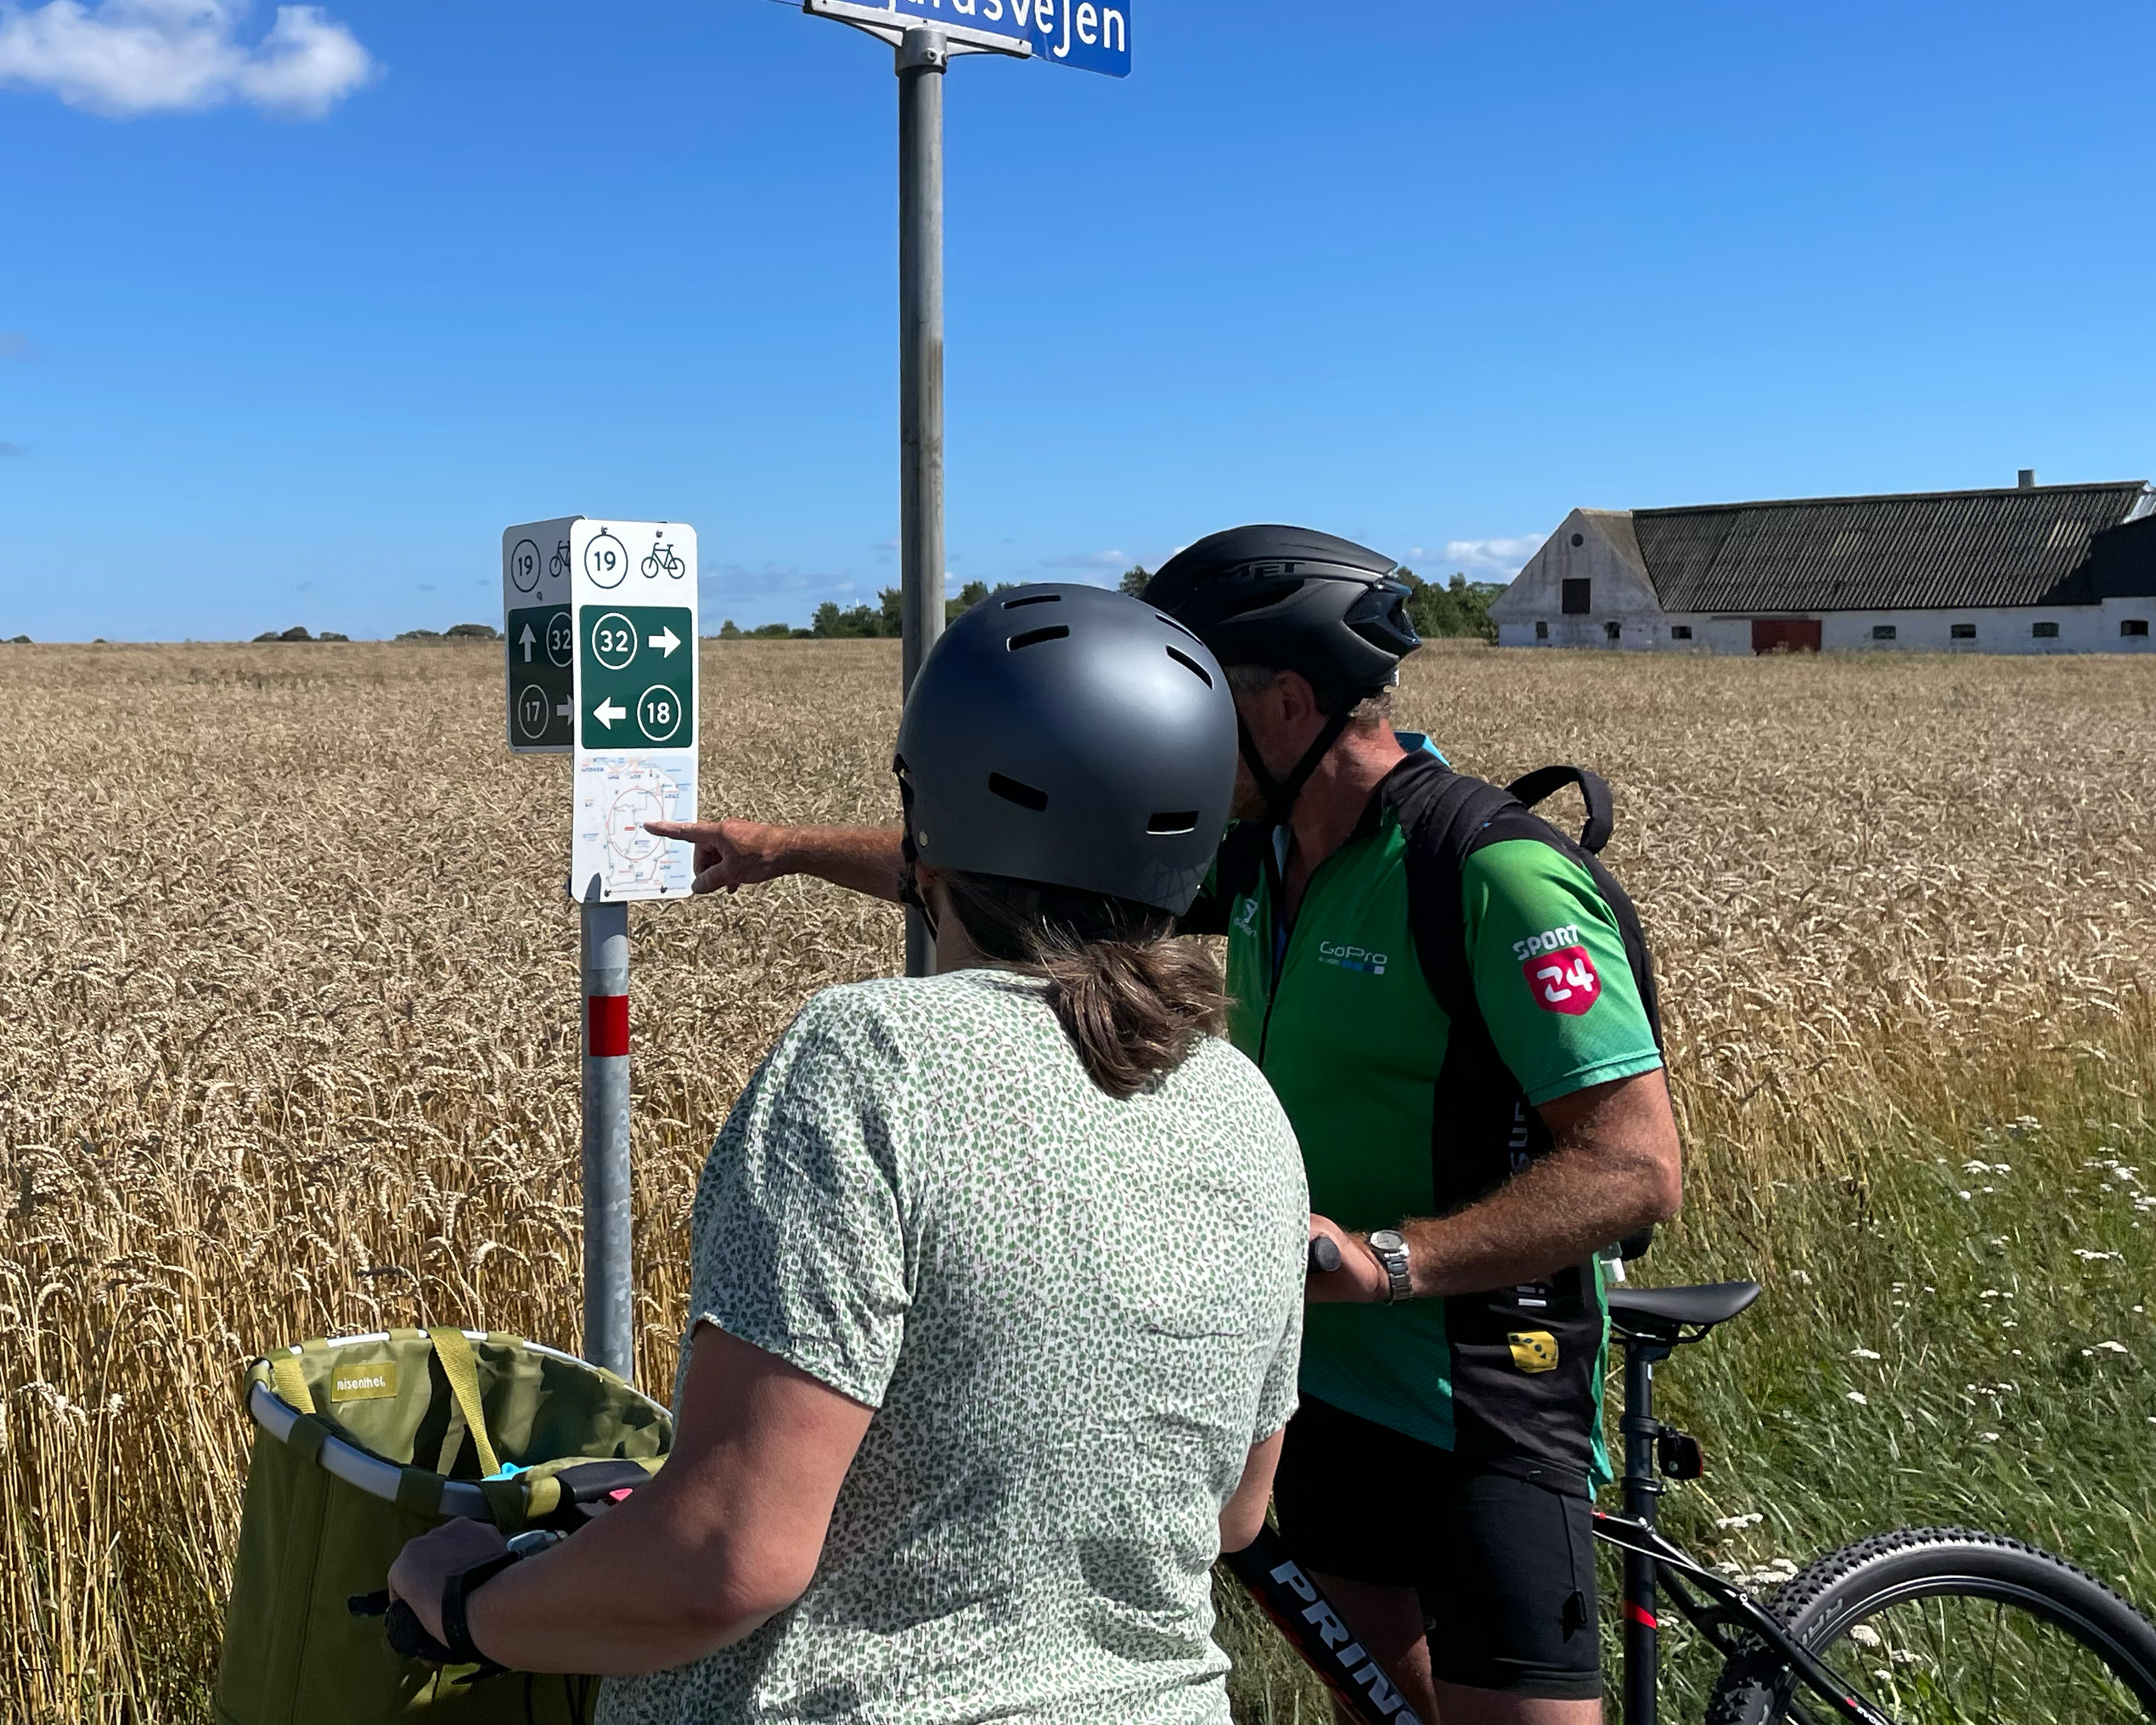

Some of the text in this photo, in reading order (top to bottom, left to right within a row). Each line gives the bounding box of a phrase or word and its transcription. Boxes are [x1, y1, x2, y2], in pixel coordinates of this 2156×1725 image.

[518, 555, 532, 577] 19
[594, 550, 616, 572] 19
[553, 629, 571, 651] 32
[600, 630, 628, 652] 32
[526, 701, 540, 722] 17
[647, 702, 670, 724] 18
[1320, 940, 1388, 965] GoPro
[1512, 924, 1580, 961] SPORT
[1537, 958, 1594, 1003] 24
